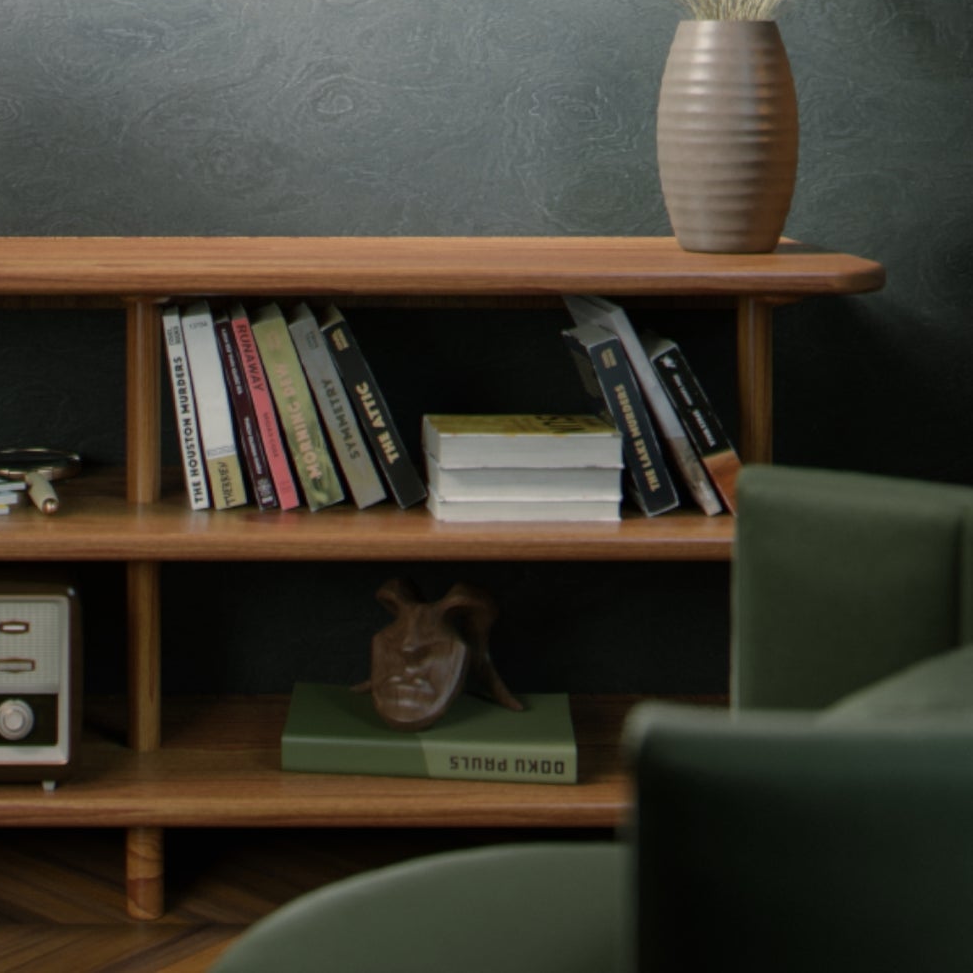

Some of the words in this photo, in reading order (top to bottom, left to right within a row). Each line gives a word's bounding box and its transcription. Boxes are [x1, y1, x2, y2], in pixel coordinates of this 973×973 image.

[237, 324, 264, 392] RUNAWAY
[275, 362, 296, 397] DEW
[173, 356, 190, 414] MURDERS
[356, 382, 385, 428] ATTIC
[322, 378, 361, 460] SYMMETRY
[613, 384, 641, 437] MURDERS
[184, 418, 200, 476] HOUSTON
[290, 401, 323, 479] MORNING
[378, 431, 400, 464] THE
[191, 481, 204, 503] THE
[644, 469, 660, 492] THE
[449, 755, 508, 772] PAULS
[515, 759, 565, 775] DOKU
